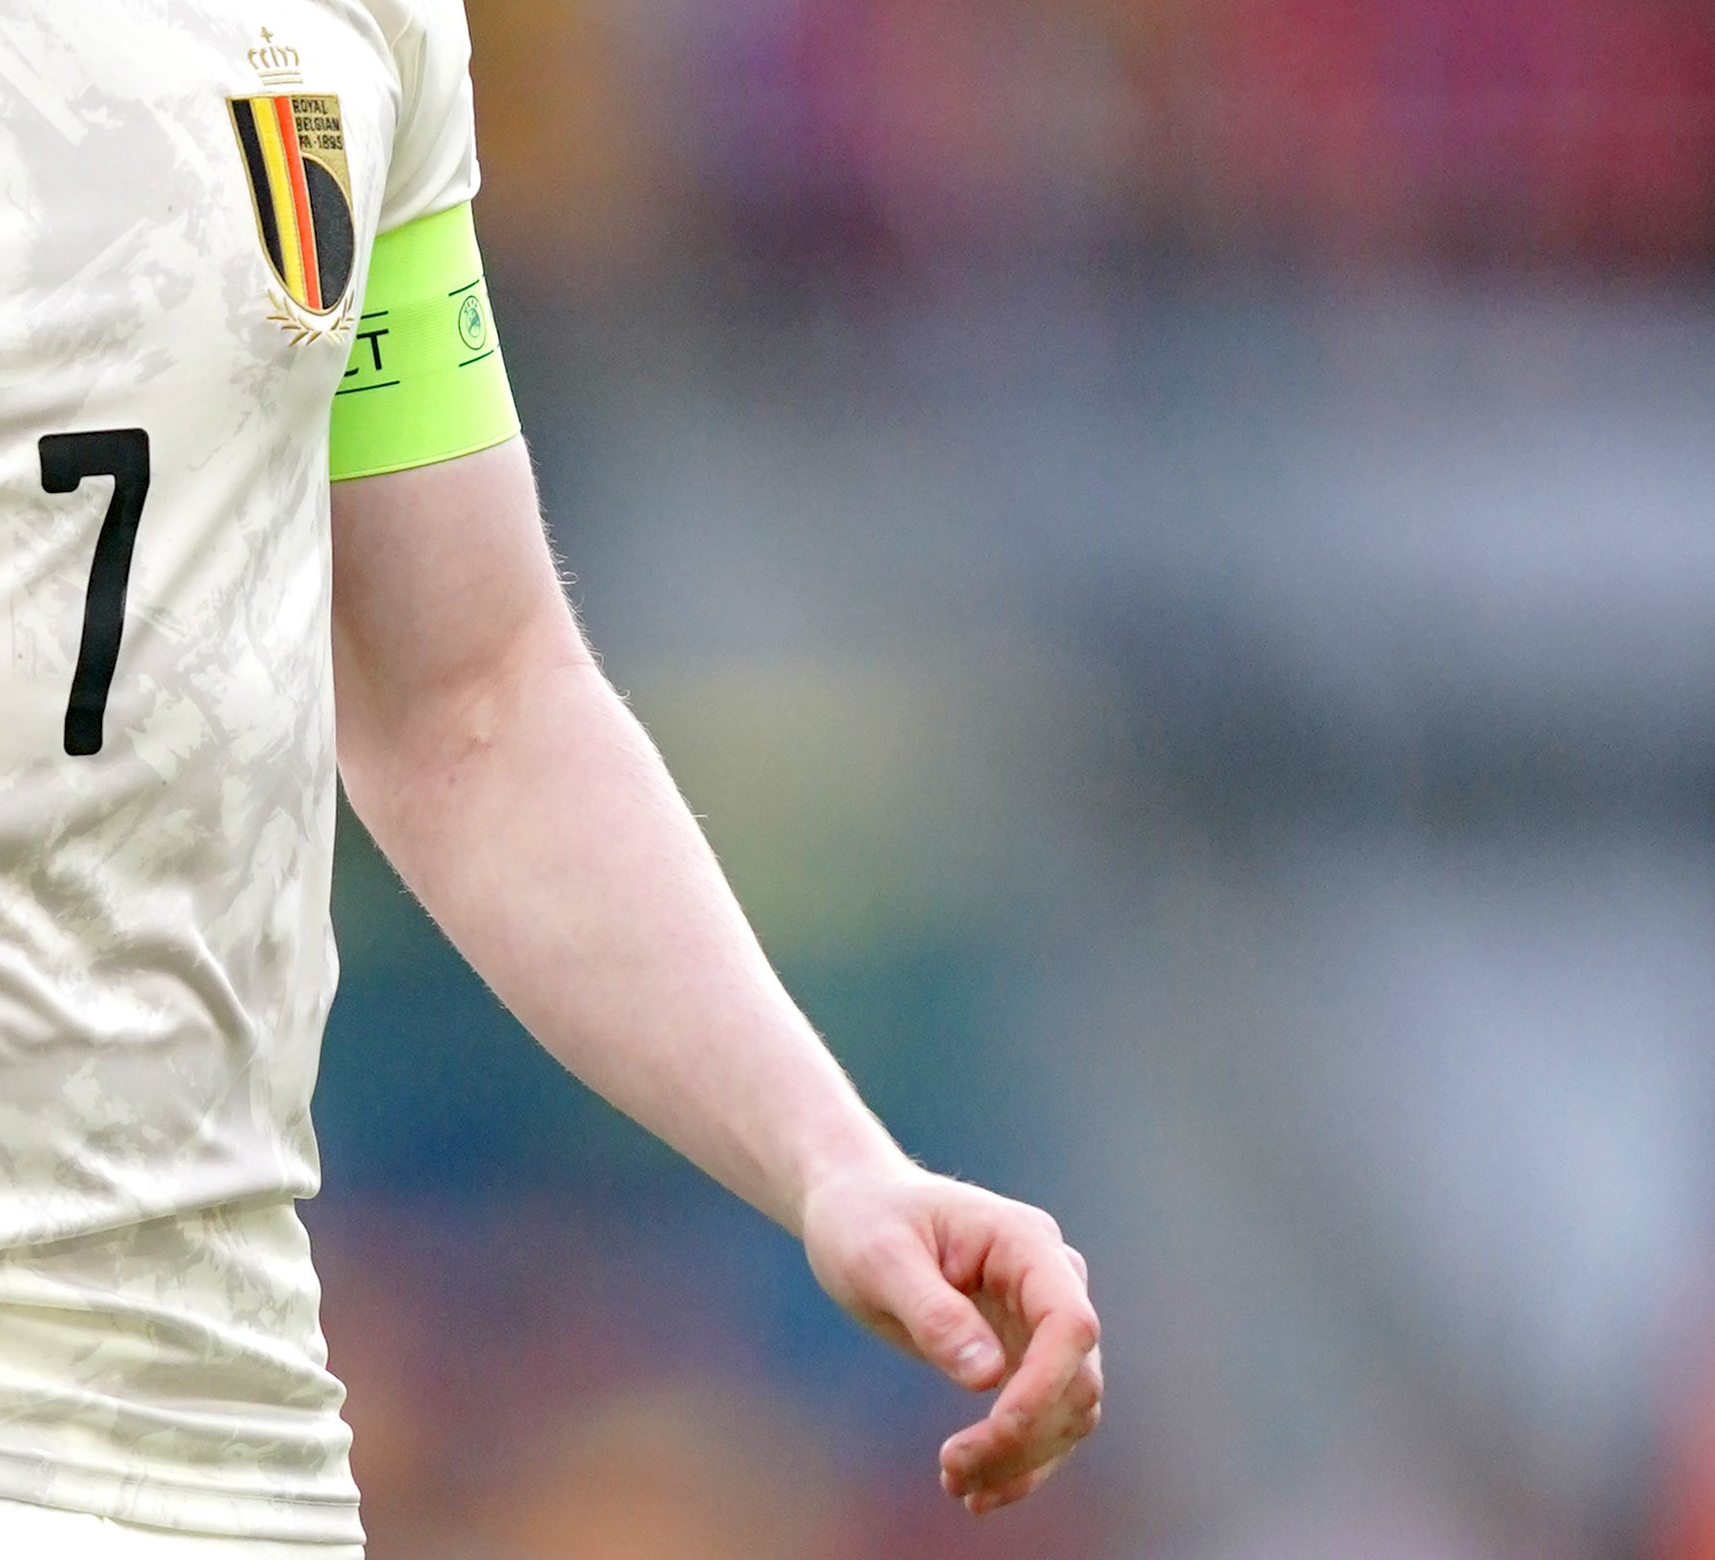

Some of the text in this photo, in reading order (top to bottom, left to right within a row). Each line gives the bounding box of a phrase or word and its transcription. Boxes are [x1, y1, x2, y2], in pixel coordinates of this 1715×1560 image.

[291, 98, 328, 115] ROYAL
[295, 116, 340, 132] BELGIAN
[38, 427, 150, 756] 7
